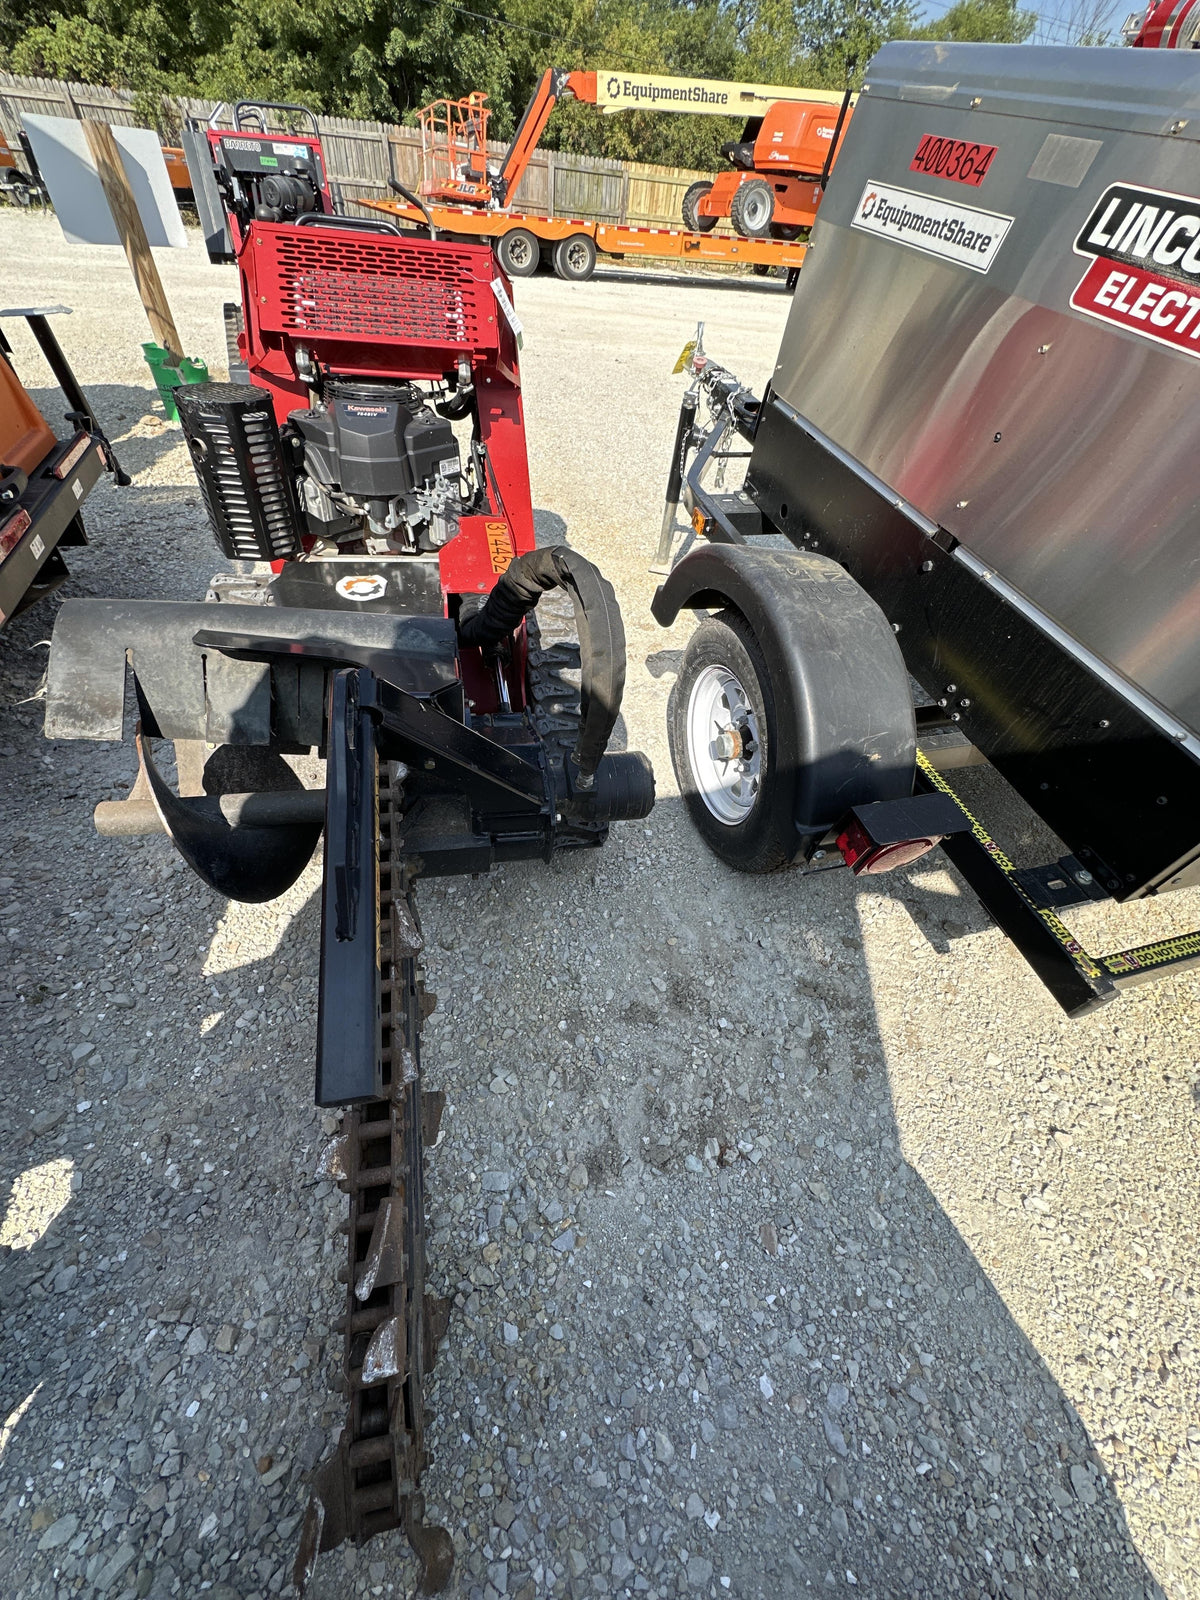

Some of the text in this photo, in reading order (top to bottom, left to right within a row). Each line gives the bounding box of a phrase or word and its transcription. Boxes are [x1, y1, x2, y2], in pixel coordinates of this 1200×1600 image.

[622, 80, 729, 105] EquipmentShare
[913, 135, 995, 184] 400364
[456, 183, 476, 195] JLG
[873, 197, 993, 254] EquipmentShare
[1093, 270, 1200, 340] ELECT
[347, 404, 388, 414] Kawasaki
[1136, 952, 1154, 963] DO
[1152, 946, 1175, 958] NOT
